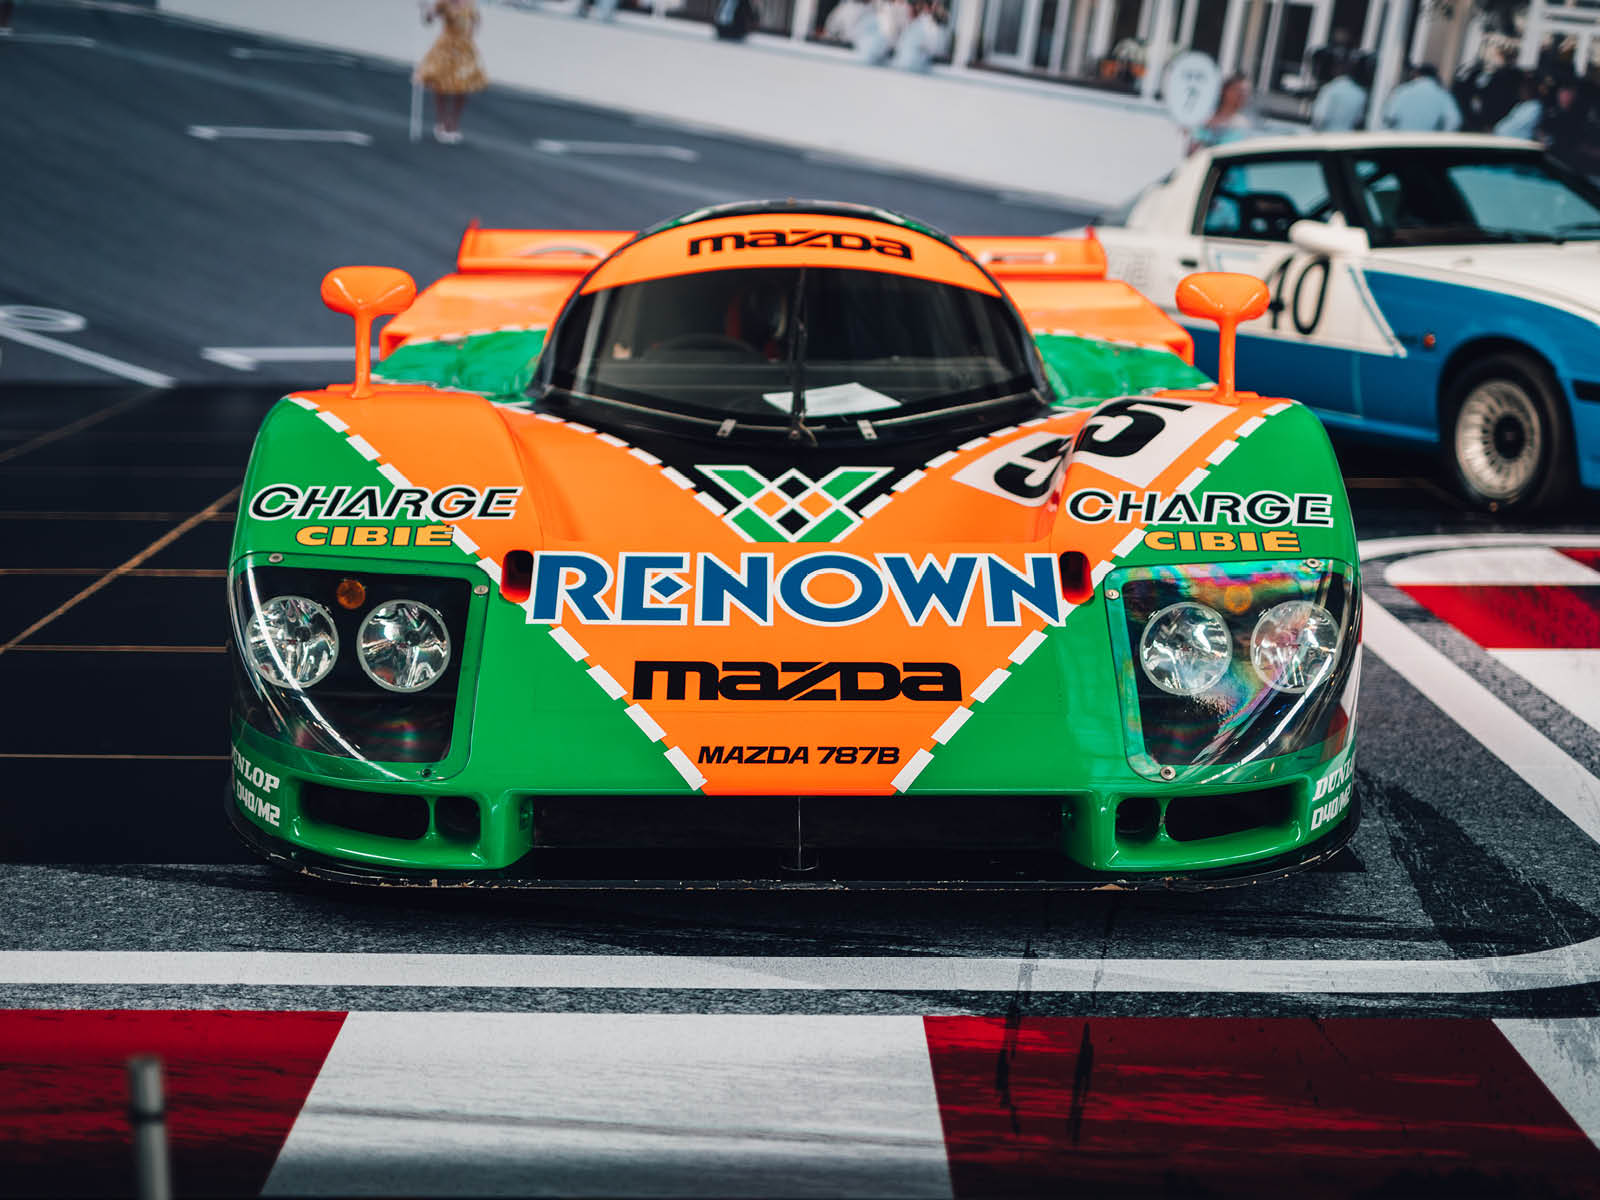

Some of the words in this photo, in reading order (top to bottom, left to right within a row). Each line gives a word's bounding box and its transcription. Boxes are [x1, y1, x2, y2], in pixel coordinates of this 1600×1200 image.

[1265, 254, 1330, 335] 40
[249, 484, 523, 520] CHARGE
[1066, 488, 1334, 528] CHARGE
[1144, 530, 1302, 552] CIBIÉ
[525, 550, 1067, 627] RENOWN
[233, 746, 280, 793] UNLOP
[697, 746, 809, 764] MAZDA
[816, 746, 900, 764] 787B
